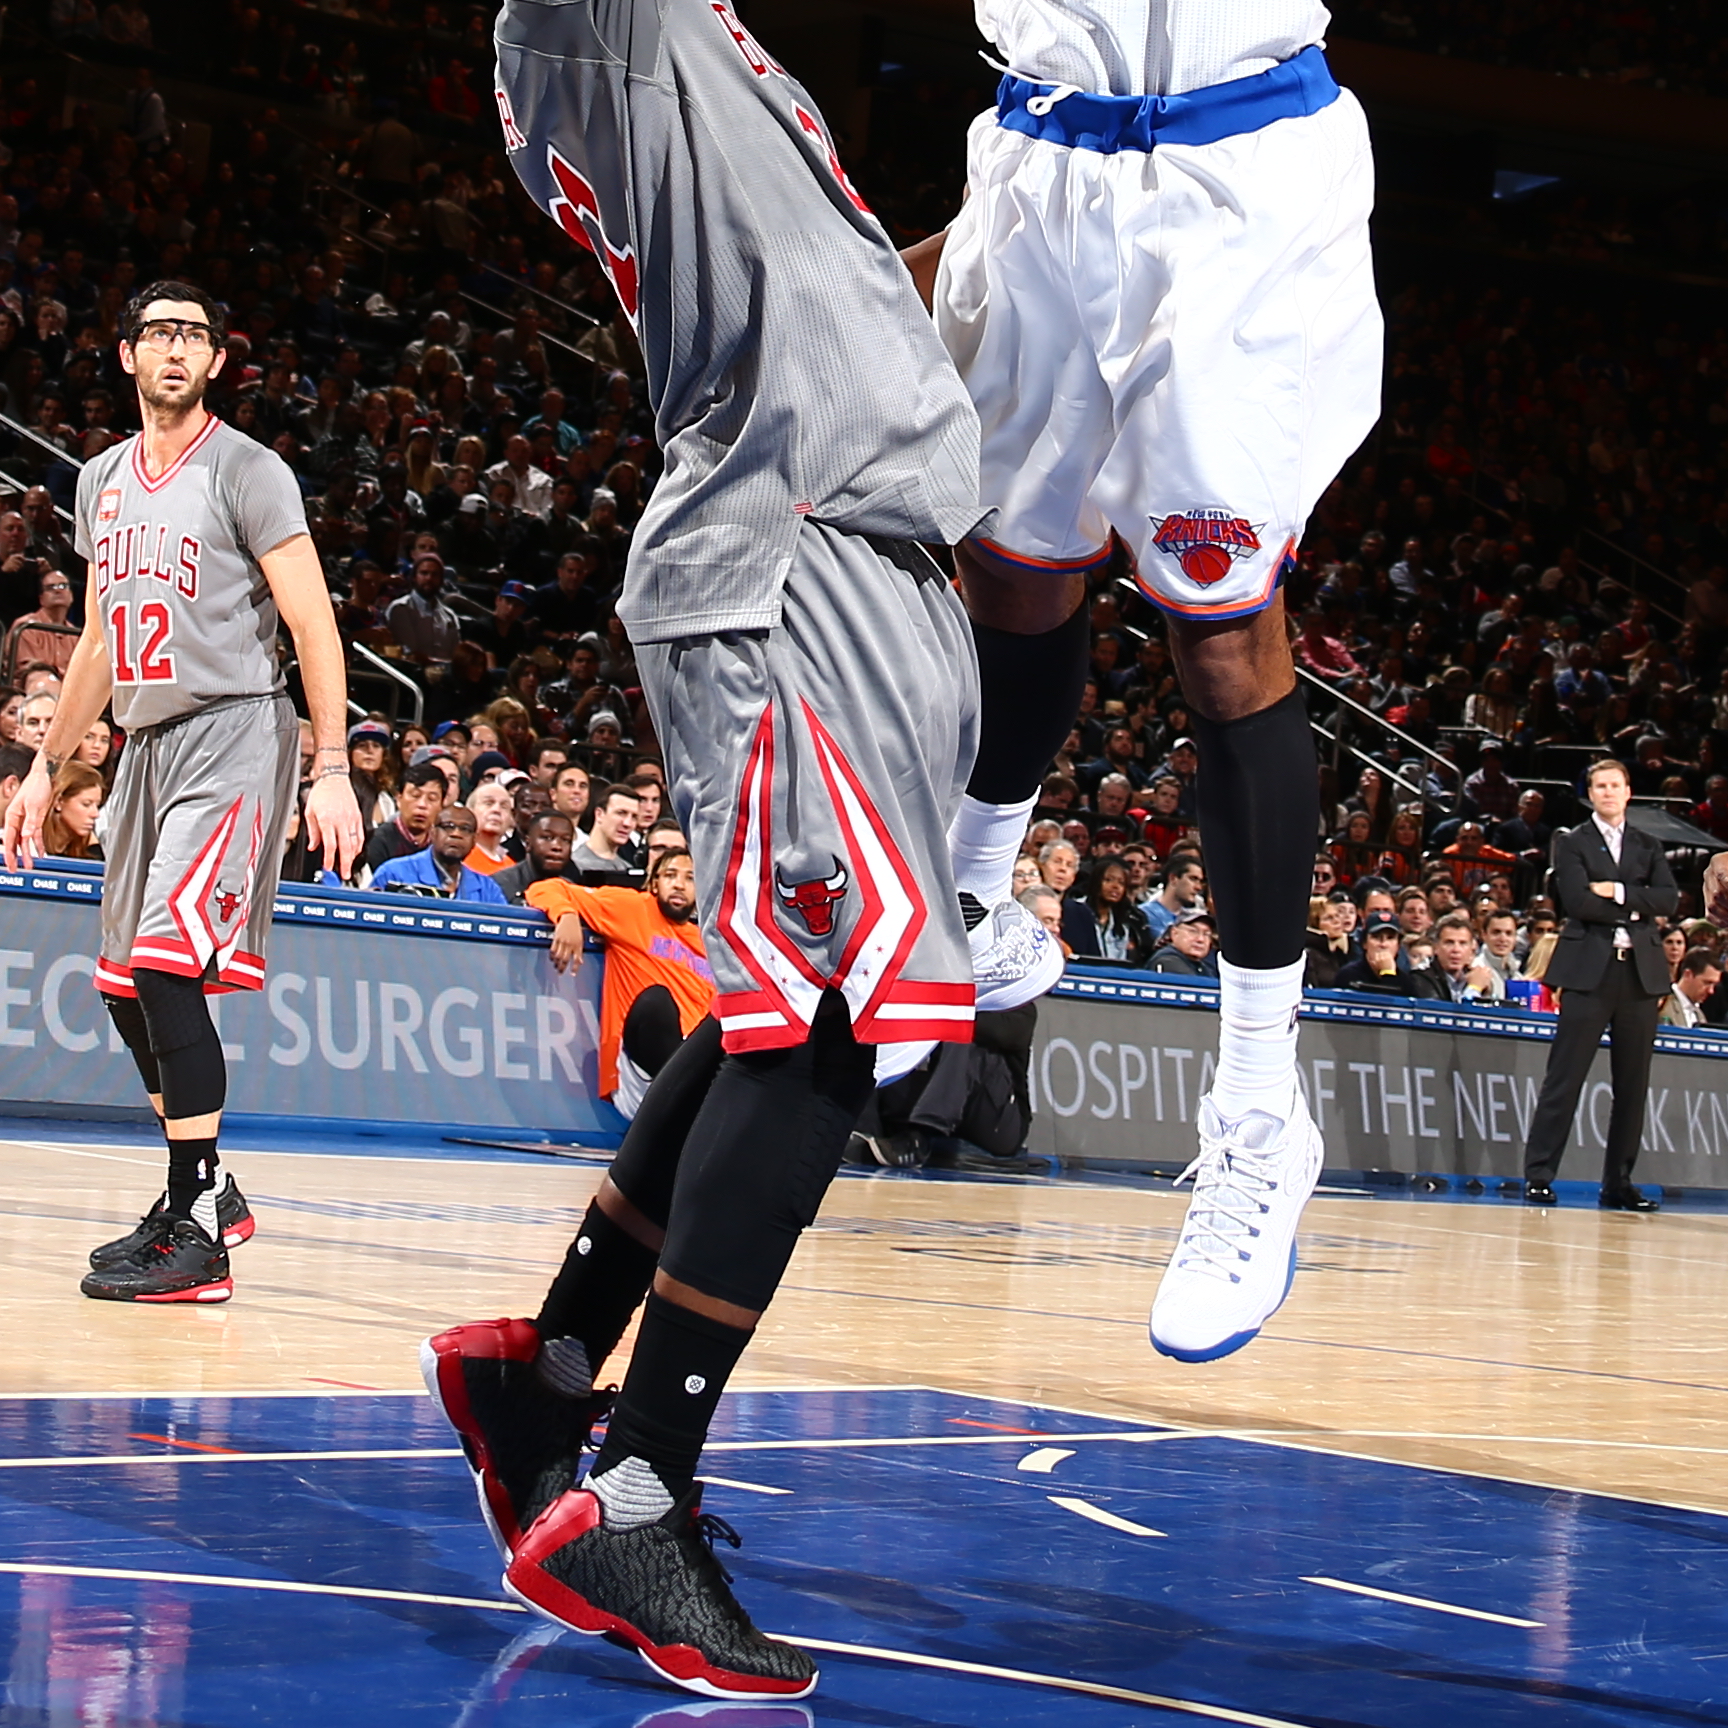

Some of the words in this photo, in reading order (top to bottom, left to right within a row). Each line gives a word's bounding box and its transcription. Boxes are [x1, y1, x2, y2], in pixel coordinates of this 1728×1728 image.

[95, 522, 202, 605] BULLS
[1152, 514, 1262, 550] KNICKS
[108, 598, 177, 687] 12
[1029, 1037, 1215, 1123] OSPIT
[1349, 1062, 1440, 1138] THE
[1453, 1073, 1541, 1144] NEW
[1574, 1080, 1676, 1152] YOK
